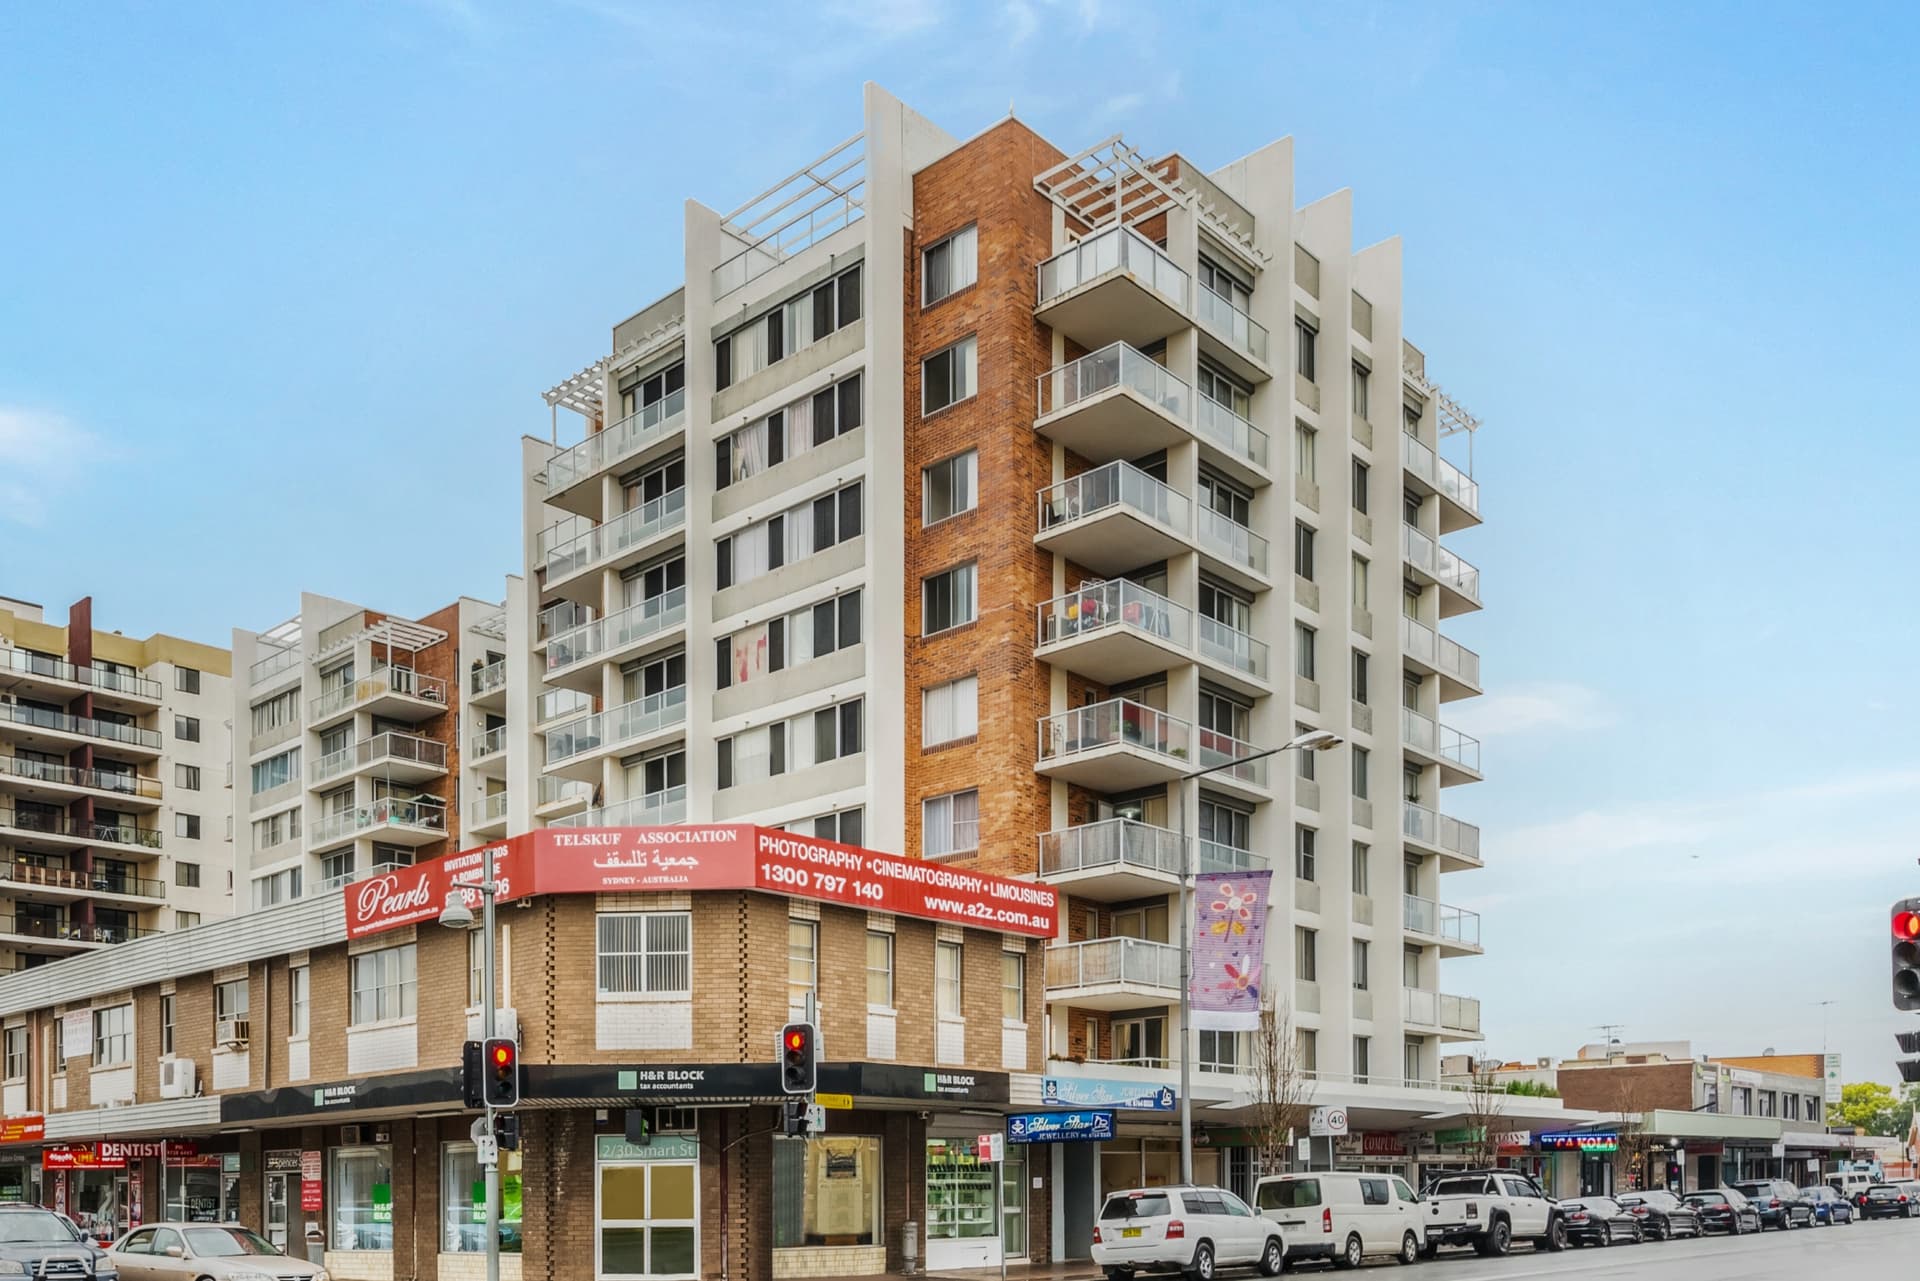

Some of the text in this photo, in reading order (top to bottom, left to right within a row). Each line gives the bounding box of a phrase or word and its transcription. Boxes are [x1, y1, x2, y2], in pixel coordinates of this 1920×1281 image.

[553, 830, 737, 846] TELSKUF ASSOCIATION
[444, 852, 482, 872] INVITATION
[652, 849, 699, 871] جمعية
[759, 835, 863, 871] PHOTOGRAPHY
[990, 881, 1055, 907] LIMOUSINES
[602, 877, 635, 885] SYDNEY
[642, 876, 688, 884] AUSTRALIA
[761, 863, 883, 900] 1300 797 140
[357, 873, 430, 922] Pearls
[924, 895, 1050, 930] www.a2z.com.au
[640, 1070, 705, 1080] H&R BLOCK
[953, 1075, 975, 1086] BLOCK
[337, 1086, 356, 1096] BLOCK
[640, 1082, 694, 1090] tax accountants
[1027, 1115, 1093, 1133] Silver Star
[1331, 1115, 1344, 1124] 40
[1037, 1132, 1080, 1141] JEWELLERY
[102, 1143, 160, 1157] DENTIST
[603, 1143, 695, 1158] 2/30 Smart St
